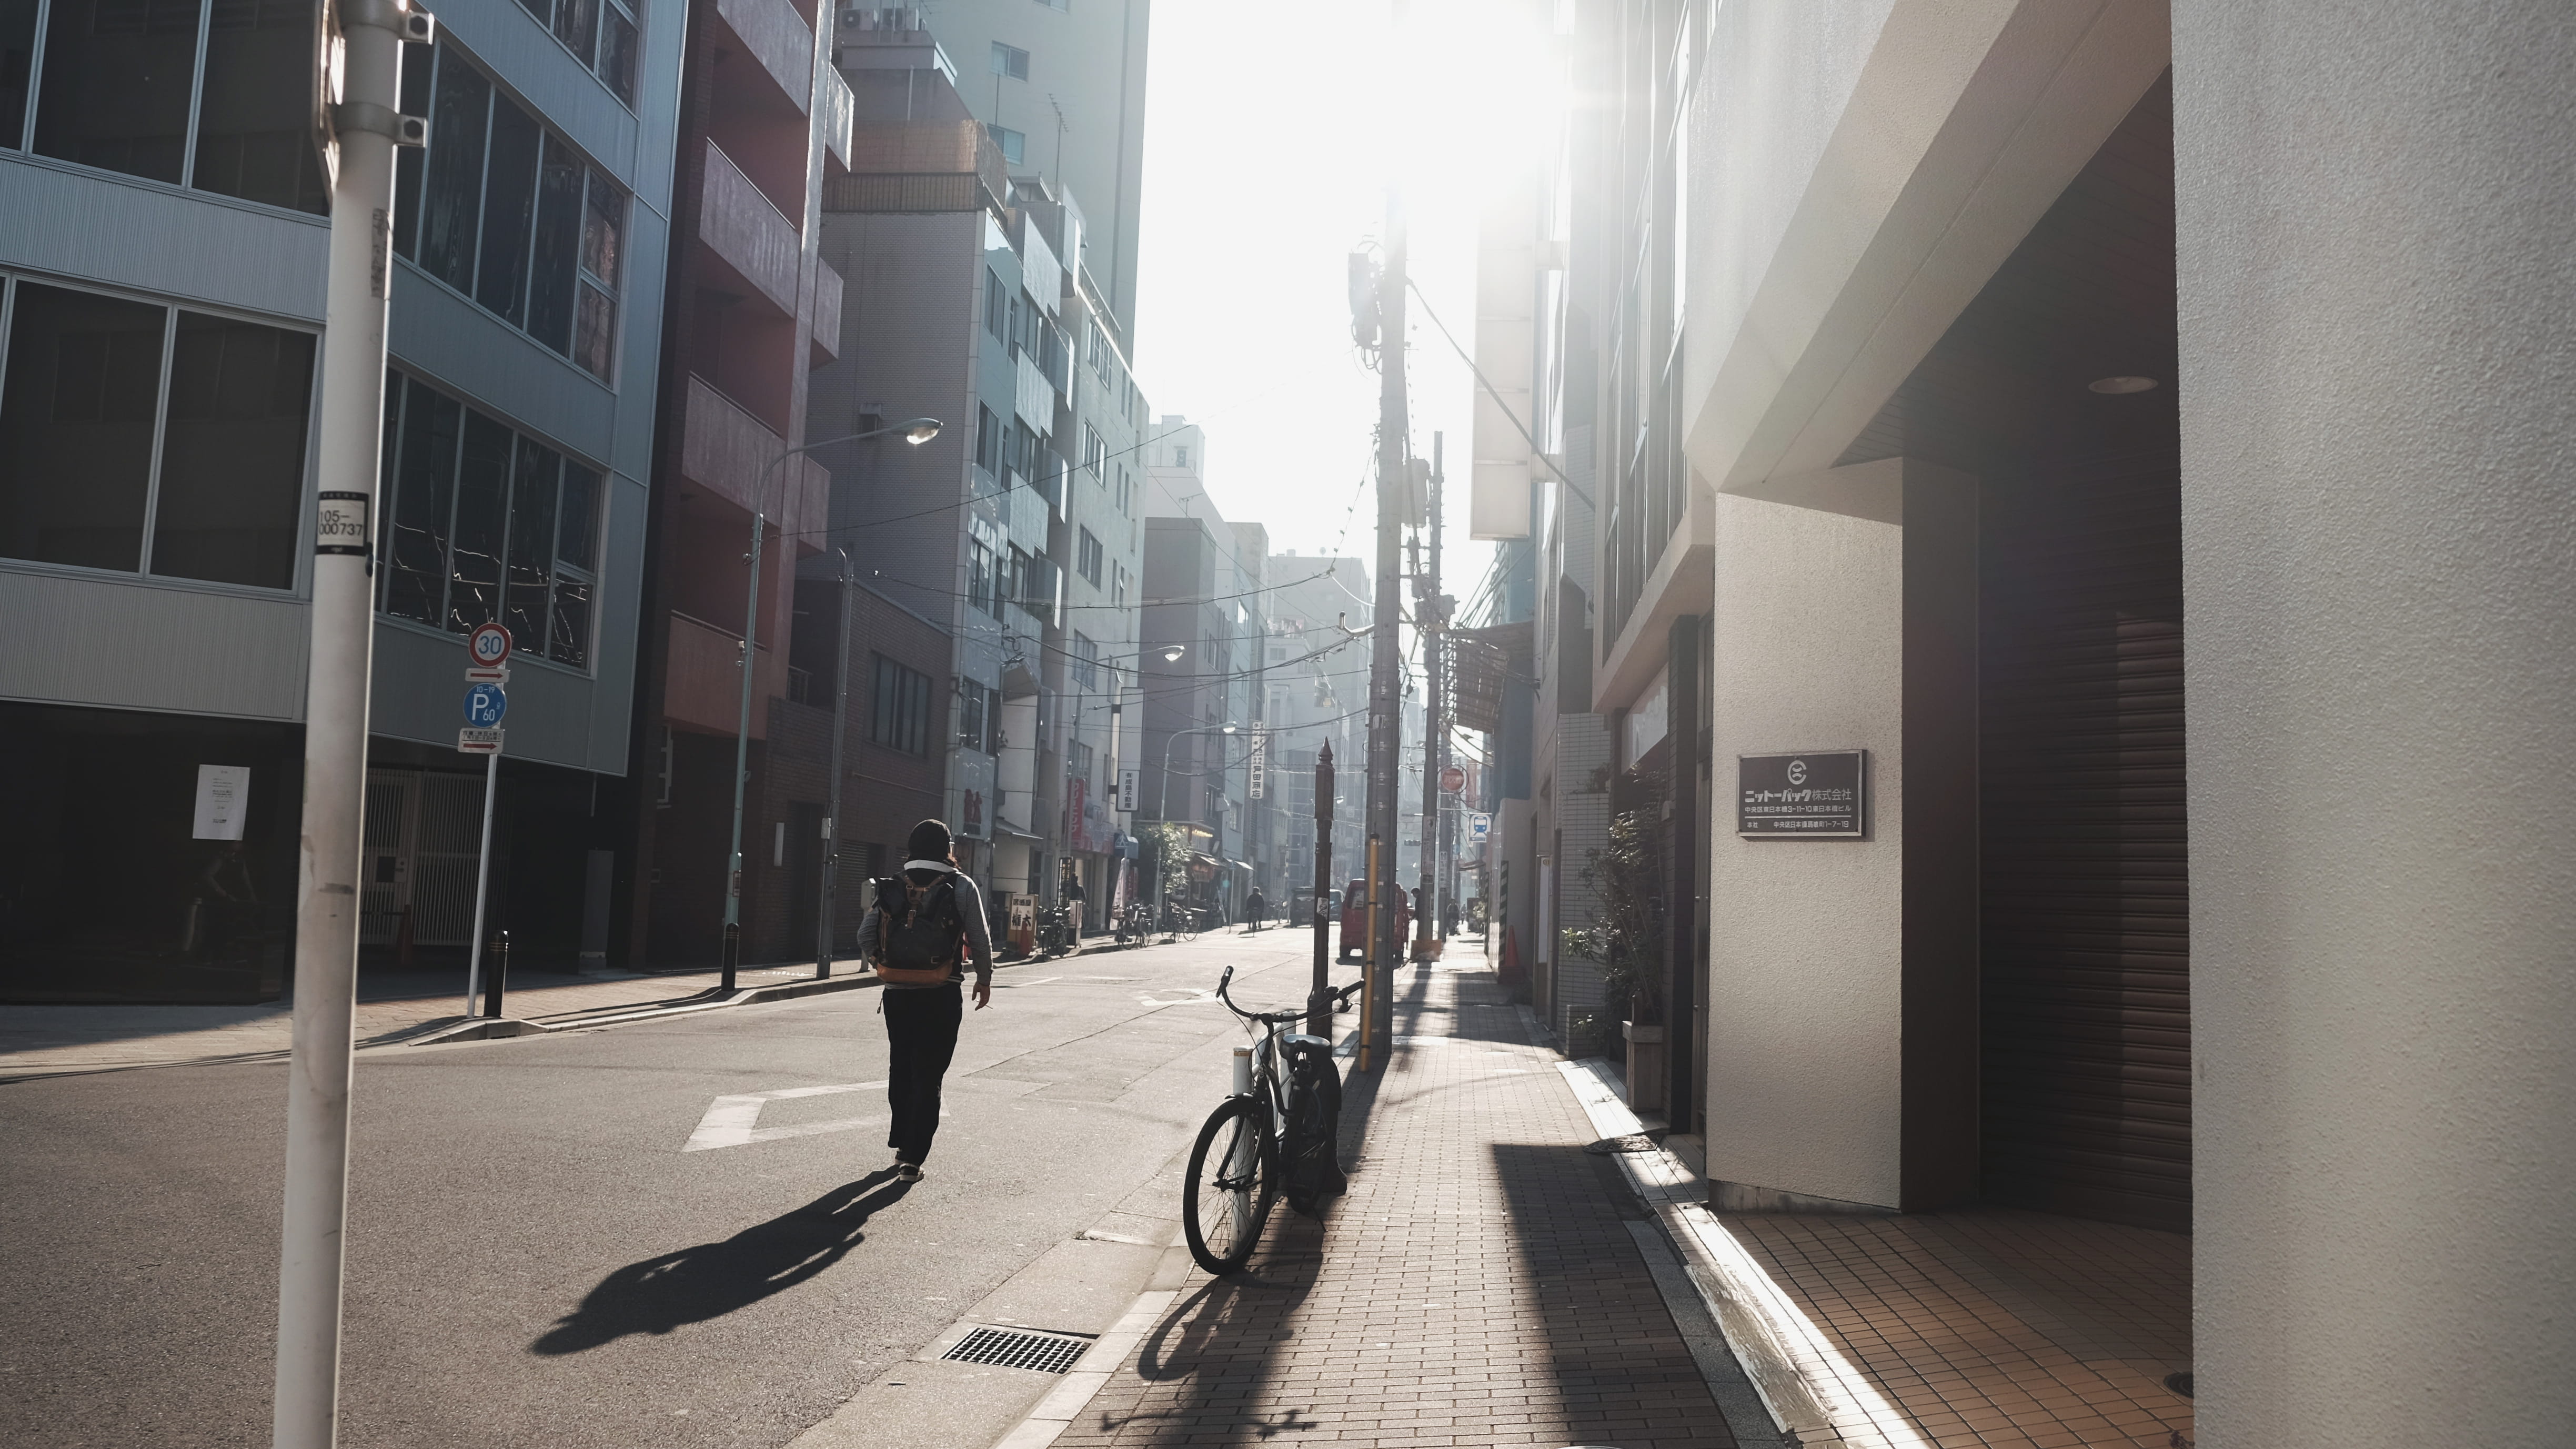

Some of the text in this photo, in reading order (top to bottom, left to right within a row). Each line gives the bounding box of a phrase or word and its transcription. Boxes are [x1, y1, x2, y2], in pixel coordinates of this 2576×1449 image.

[320, 510, 350, 522] 105-
[319, 523, 363, 536] 000737
[478, 635, 502, 655] 30
[472, 693, 489, 721] P
[482, 709, 495, 721] 60
[1252, 766, 1261, 798] 戸田商店
